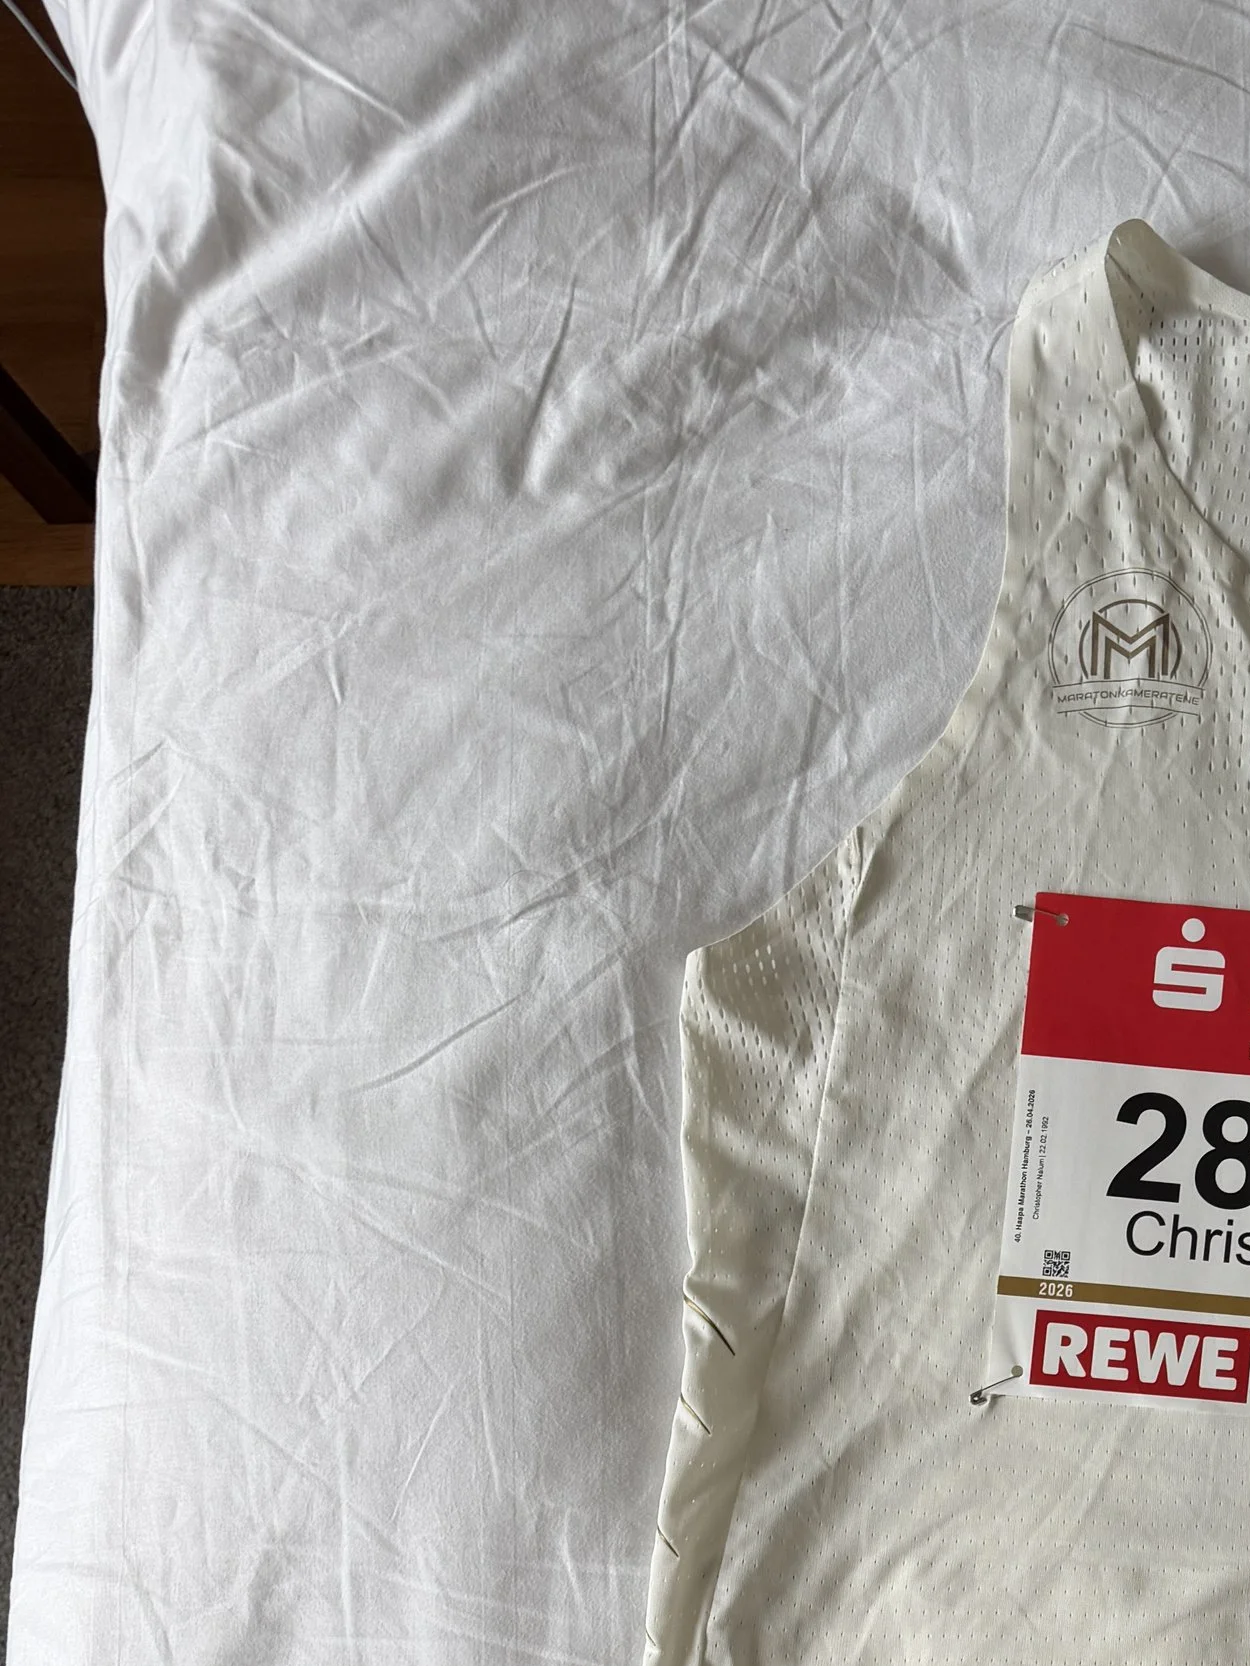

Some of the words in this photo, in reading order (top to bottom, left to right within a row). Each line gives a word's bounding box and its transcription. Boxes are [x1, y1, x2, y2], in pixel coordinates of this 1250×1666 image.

[1057, 688, 1200, 706] MARATONKAMERATENE
[1025, 1089, 1036, 1129] 26.04.2026
[1021, 1135, 1033, 1170] Hamburg
[1018, 1171, 1028, 1206] Marathon
[1033, 1181, 1043, 1220] Christopher
[1016, 1206, 1026, 1231] Haspa
[1039, 1282, 1073, 1299] 2026
[1042, 1321, 1239, 1391] REWE
